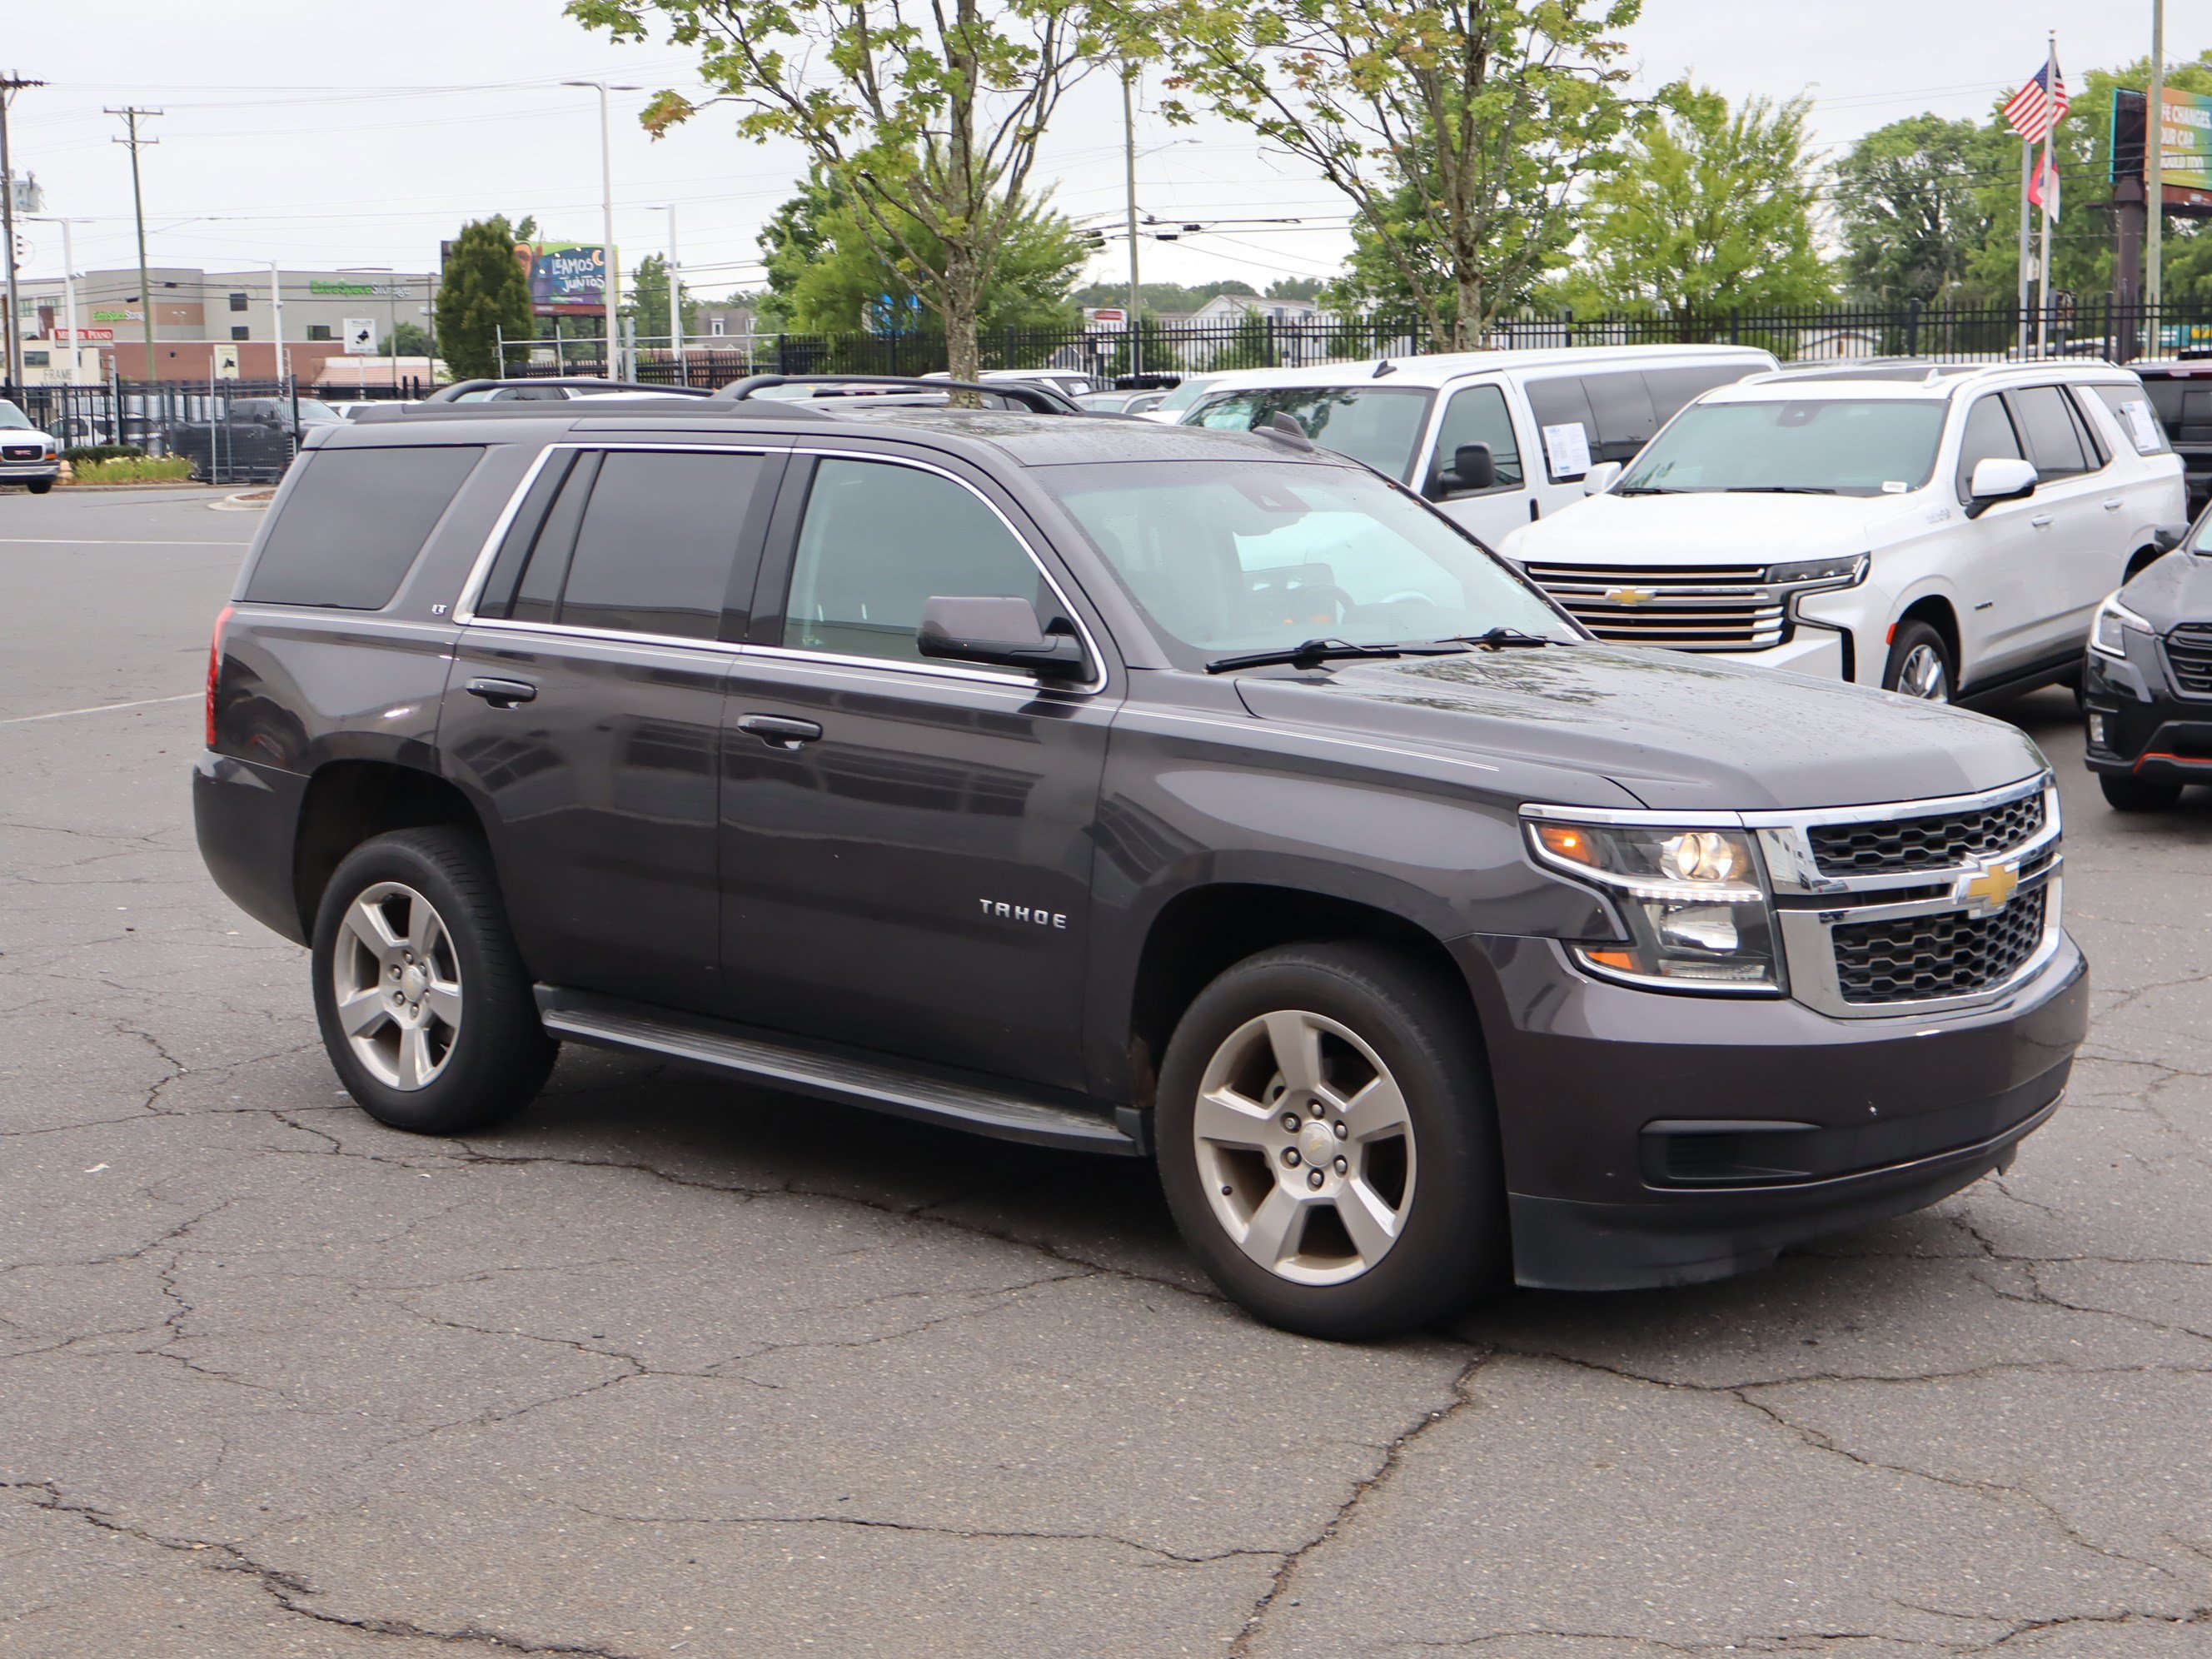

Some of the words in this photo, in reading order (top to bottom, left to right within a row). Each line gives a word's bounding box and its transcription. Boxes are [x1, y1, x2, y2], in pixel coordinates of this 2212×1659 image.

[2178, 130, 2195, 149] CAR
[551, 257, 595, 276] LEAMOS
[559, 274, 605, 293] JUNTOS
[43, 369, 73, 381] FRAME
[979, 899, 1067, 929] TAHOE
